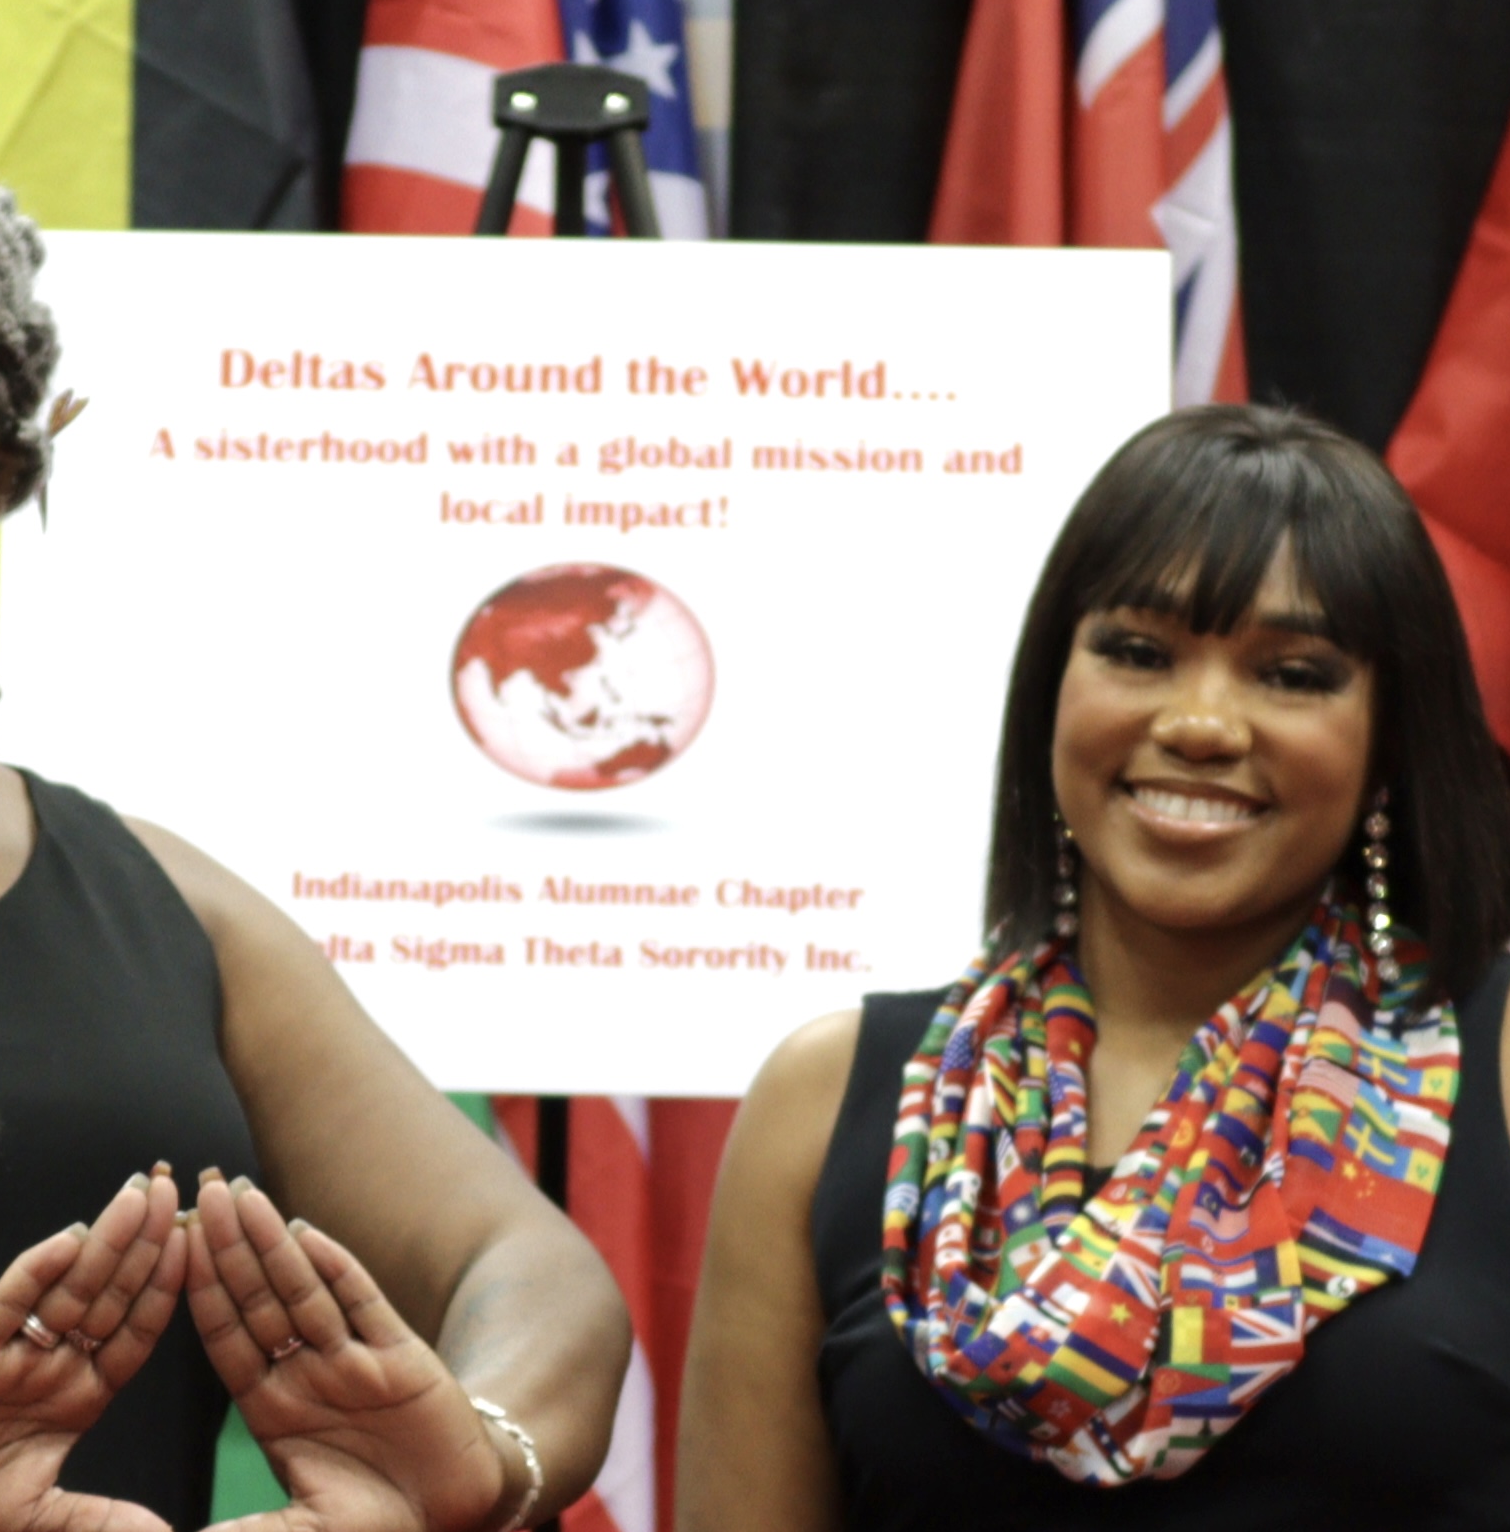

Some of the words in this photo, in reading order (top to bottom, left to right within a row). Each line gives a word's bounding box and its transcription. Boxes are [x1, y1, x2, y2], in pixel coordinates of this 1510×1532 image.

[220, 347, 387, 391] Deltas
[409, 351, 603, 396] Around
[626, 354, 708, 398] the
[730, 356, 957, 402] World....
[151, 427, 177, 461] A
[194, 429, 429, 466] sisterhood
[447, 433, 537, 467] with
[555, 442, 580, 468] a
[598, 435, 733, 476] global
[751, 441, 924, 474] mission
[942, 442, 1024, 476] and
[439, 490, 544, 526] local
[562, 496, 730, 536] impact!
[292, 870, 523, 908] Indianapolis
[540, 875, 700, 907] Alumnae
[714, 879, 864, 915] Chapter
[390, 936, 506, 971] Sigma
[523, 936, 624, 969] Theta
[638, 940, 788, 976] Sorority
[804, 942, 872, 973] Inc.
